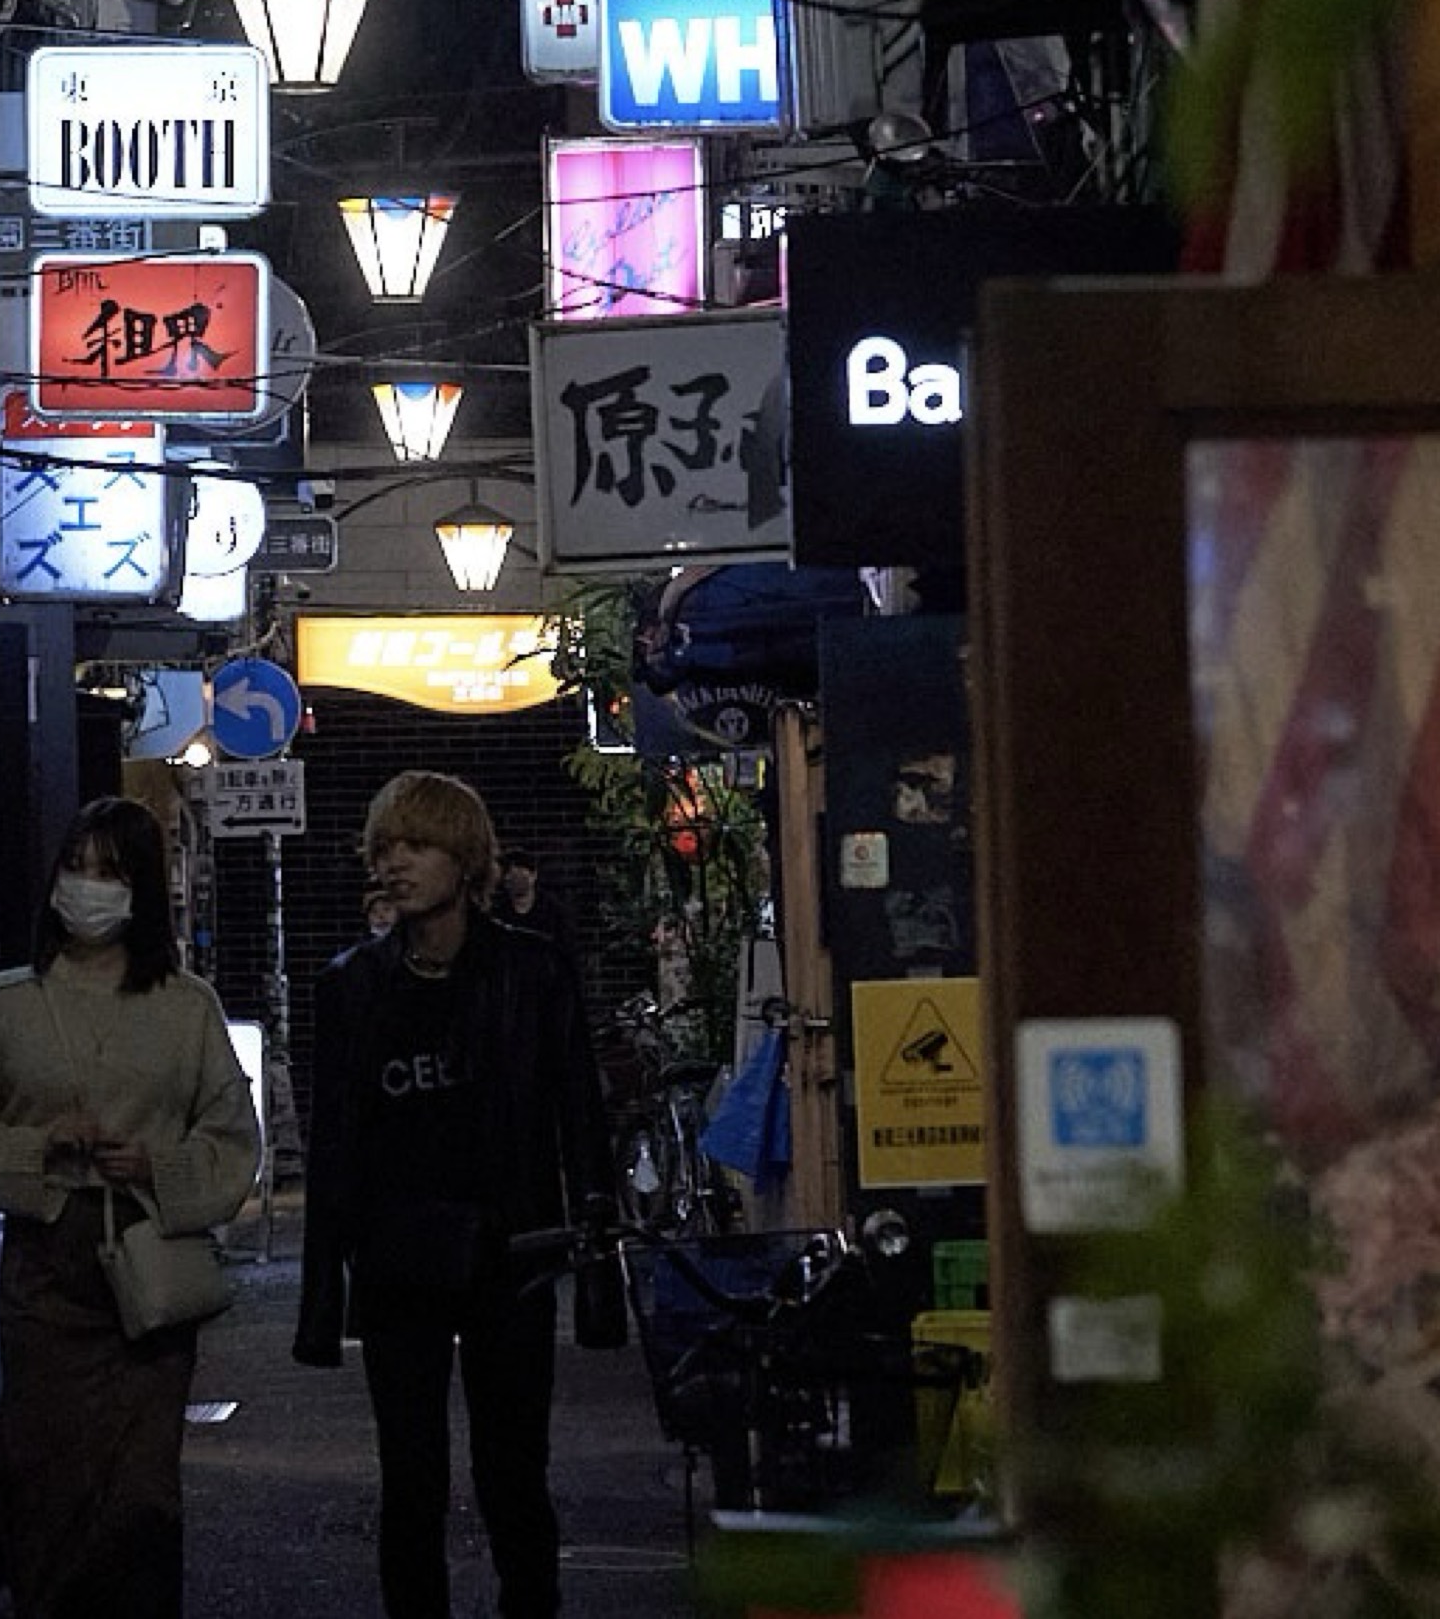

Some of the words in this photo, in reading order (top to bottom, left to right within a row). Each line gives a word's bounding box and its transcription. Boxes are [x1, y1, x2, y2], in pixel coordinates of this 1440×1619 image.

[61, 120, 234, 188] BOOTH
[63, 299, 242, 380] 租界
[561, 364, 748, 508] 原子
